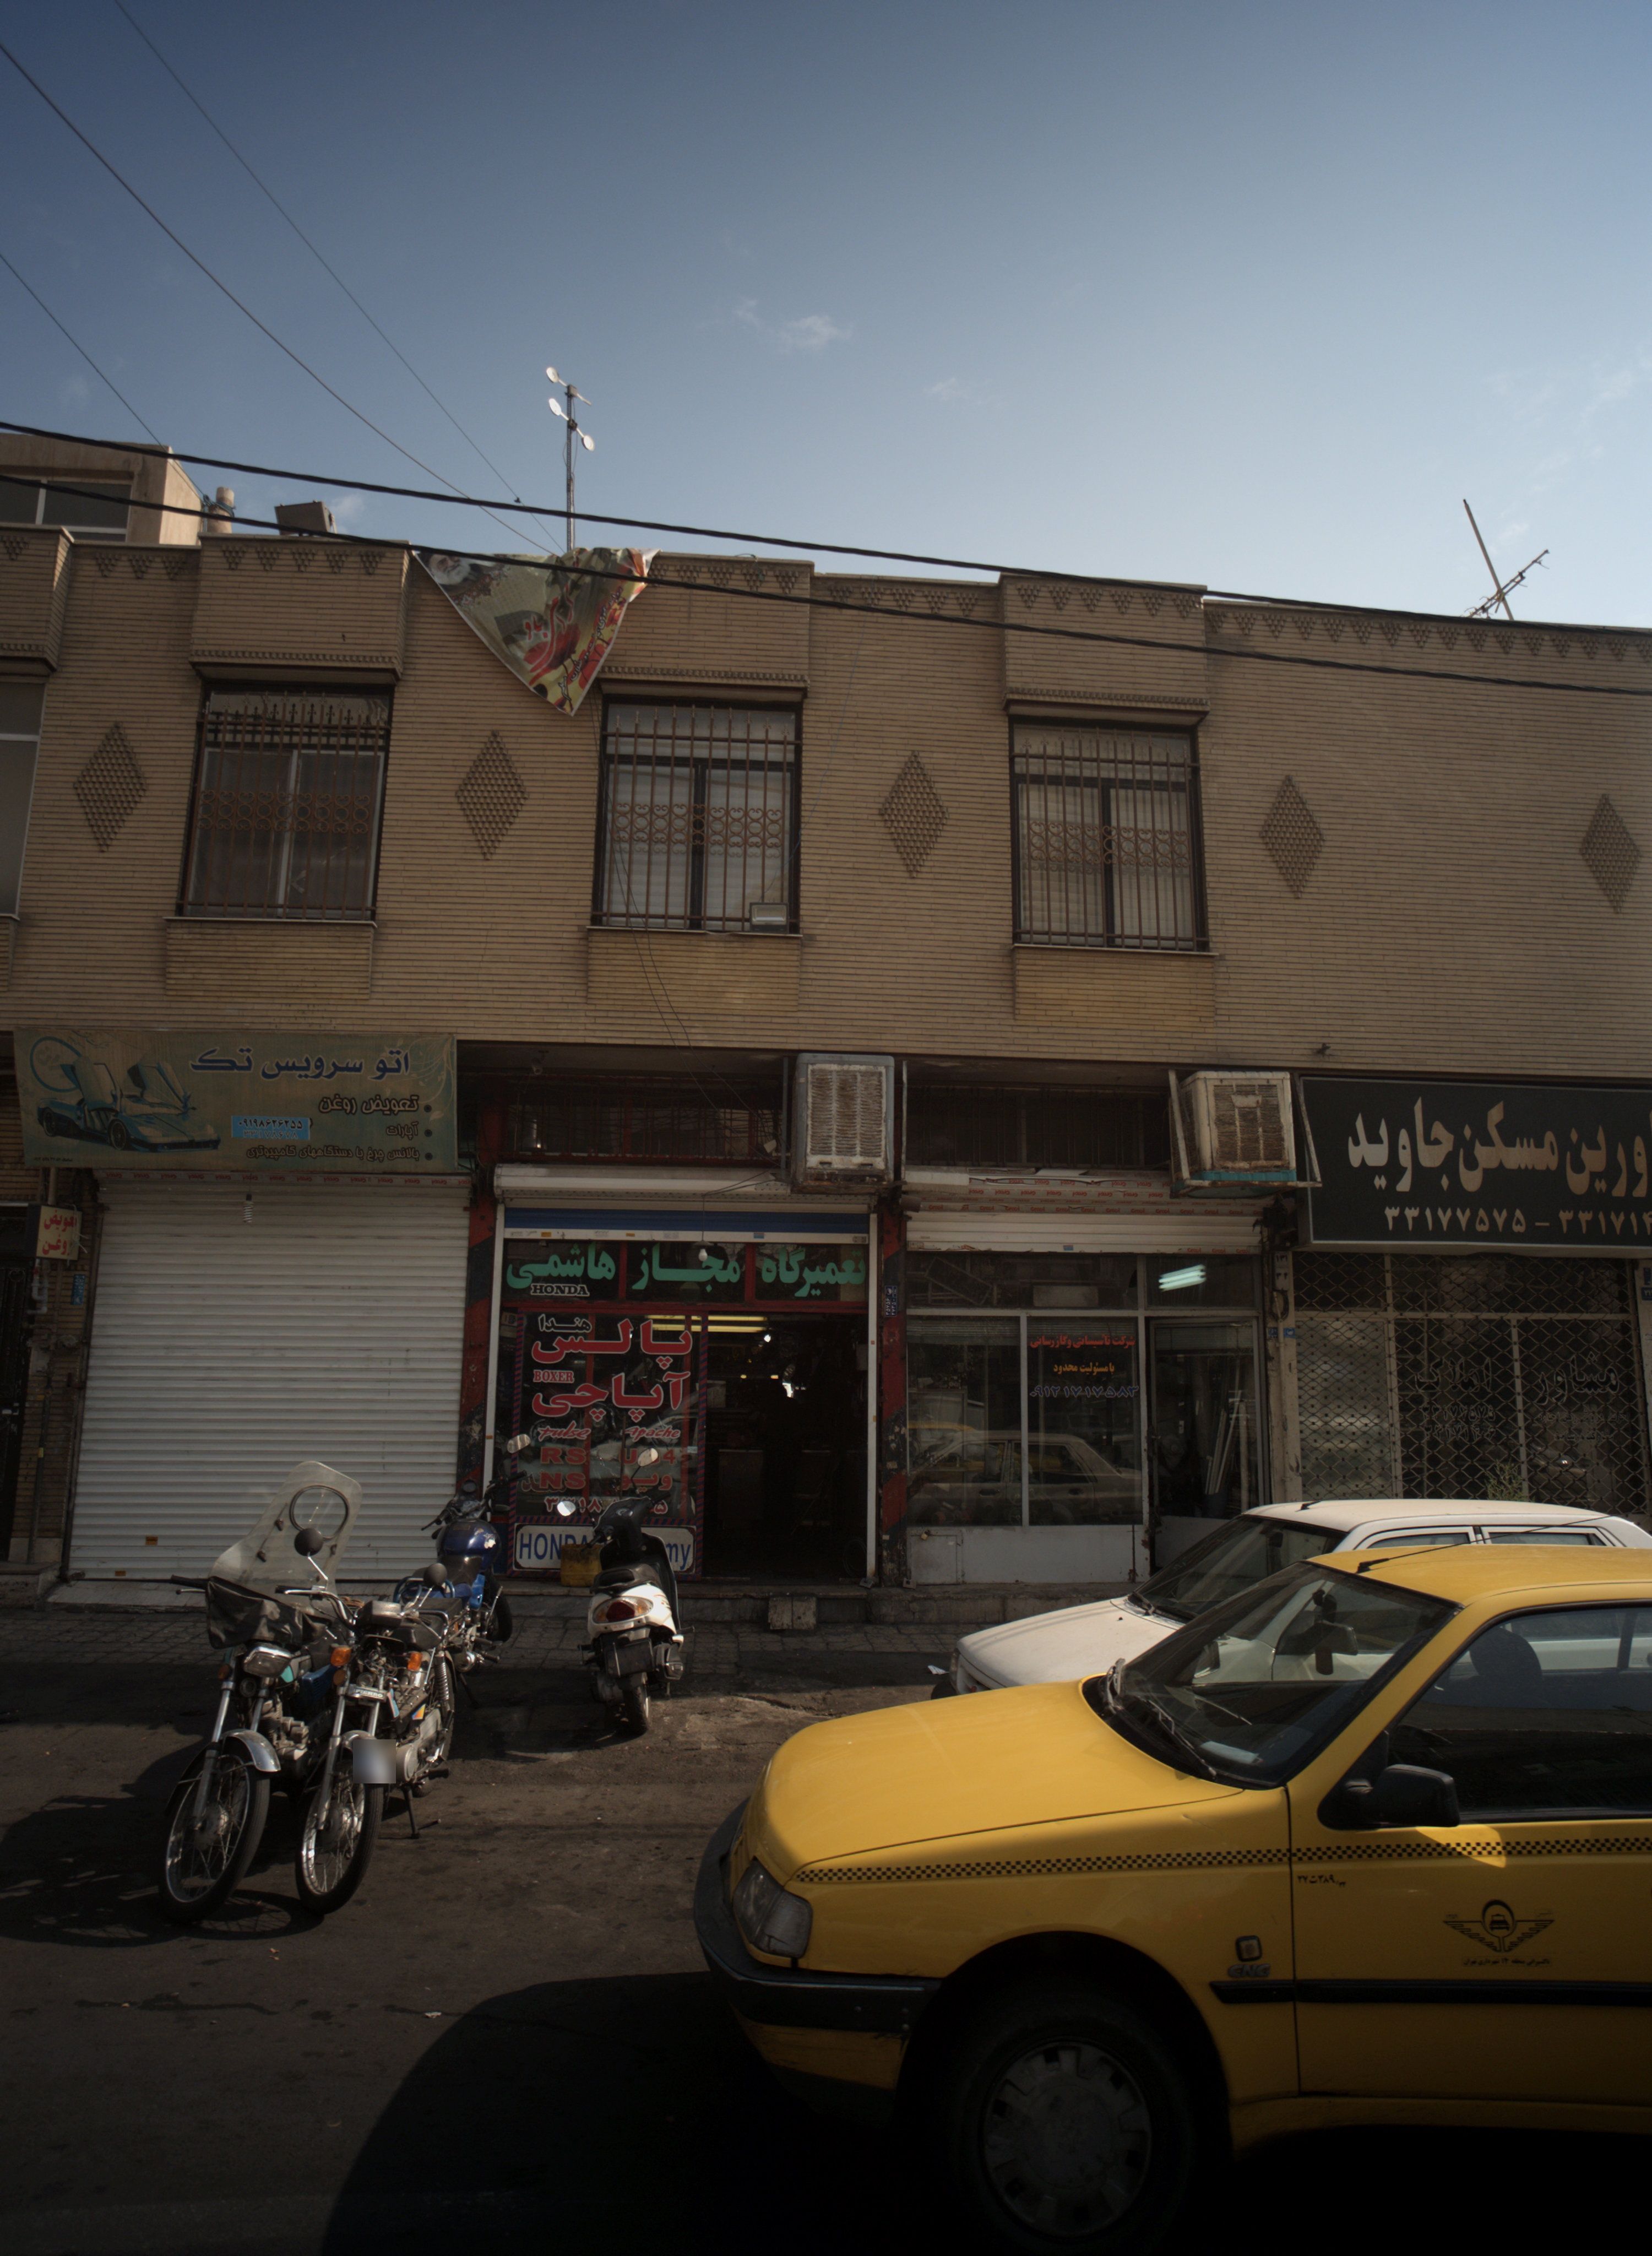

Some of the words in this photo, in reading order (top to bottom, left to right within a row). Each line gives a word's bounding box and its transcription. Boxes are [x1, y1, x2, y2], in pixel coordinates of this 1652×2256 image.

[191, 1047, 252, 1072] تک
[262, 1055, 363, 1081] سرویس
[369, 1048, 409, 1081] اتو
[319, 1094, 357, 1115] روغن
[362, 1094, 419, 1115] تعویض
[386, 1121, 419, 1140] آپارات
[355, 1146, 364, 1159] با
[366, 1147, 385, 1163] چرخ
[387, 1147, 420, 1160] بالانس
[1348, 1097, 1454, 1192] جاوید
[1459, 1100, 1558, 1192] مسکن
[1566, 1108, 1652, 1197] ورین
[1384, 1206, 1526, 1233] ۳۳۱۷۷۵۷۵
[506, 1241, 616, 1289] هاشمی
[632, 1242, 741, 1293] مجاز
[762, 1246, 866, 1297] تعمیرگاه
[531, 1283, 590, 1297] HONDA
[537, 1314, 592, 1332] هندا
[531, 1318, 693, 1370] پالس
[1112, 1335, 1135, 1348] شرکت
[532, 1369, 574, 1384] BOXER
[1053, 1364, 1078, 1375] محدود
[532, 1371, 691, 1423] آپاچی
[540, 1447, 586, 1464] RS
[540, 1472, 586, 1489] NS
[1227, 1964, 1270, 1978] CNG
